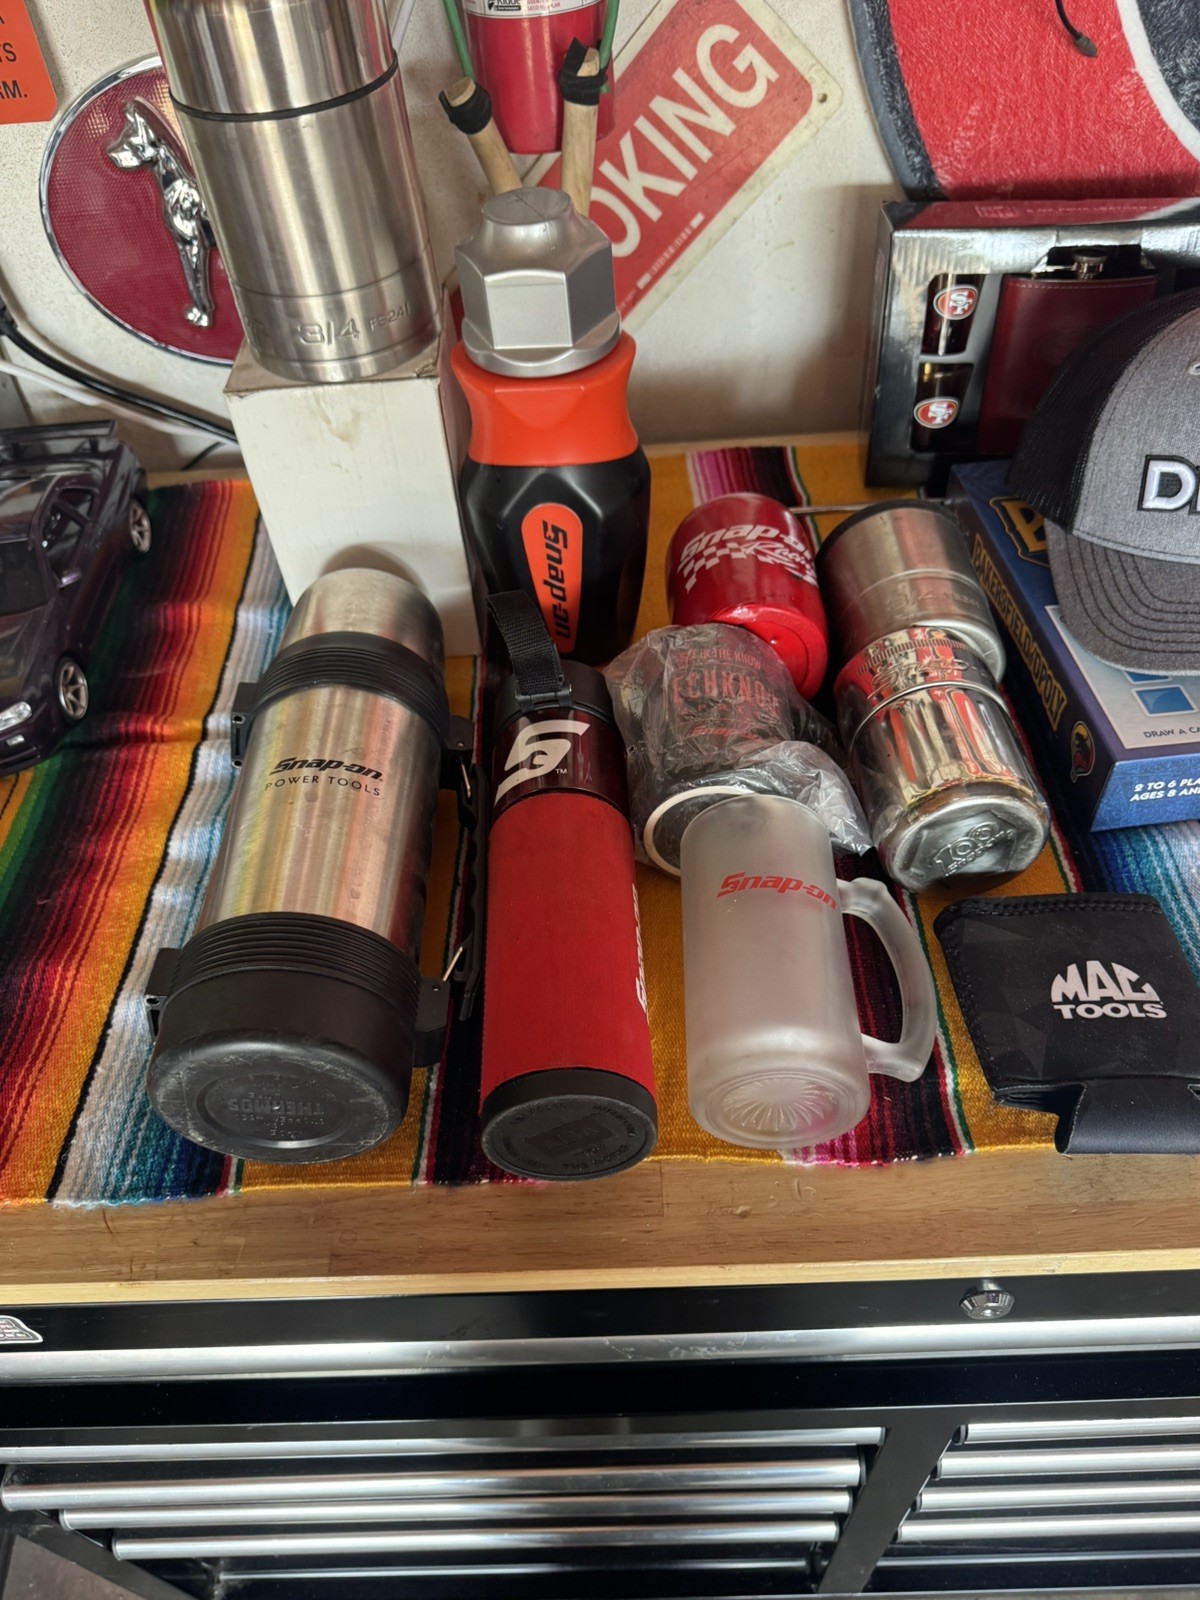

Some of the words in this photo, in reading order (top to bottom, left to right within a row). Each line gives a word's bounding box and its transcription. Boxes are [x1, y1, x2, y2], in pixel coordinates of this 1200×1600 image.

[1143, 728, 1174, 739] DRAW
[1179, 727, 1188, 735] A
[269, 757, 384, 781] Snap-on
[264, 775, 319, 792] POWER
[328, 776, 381, 797] TOOLS
[1129, 790, 1165, 802] AGES
[1166, 789, 1177, 797] 8
[1134, 784, 1144, 792] 2
[1147, 781, 1166, 790] TO
[1167, 780, 1178, 788] 6
[716, 872, 837, 911] Snap-on
[1051, 960, 1161, 1002] MAC
[1053, 1002, 1168, 1019] TOOLS
